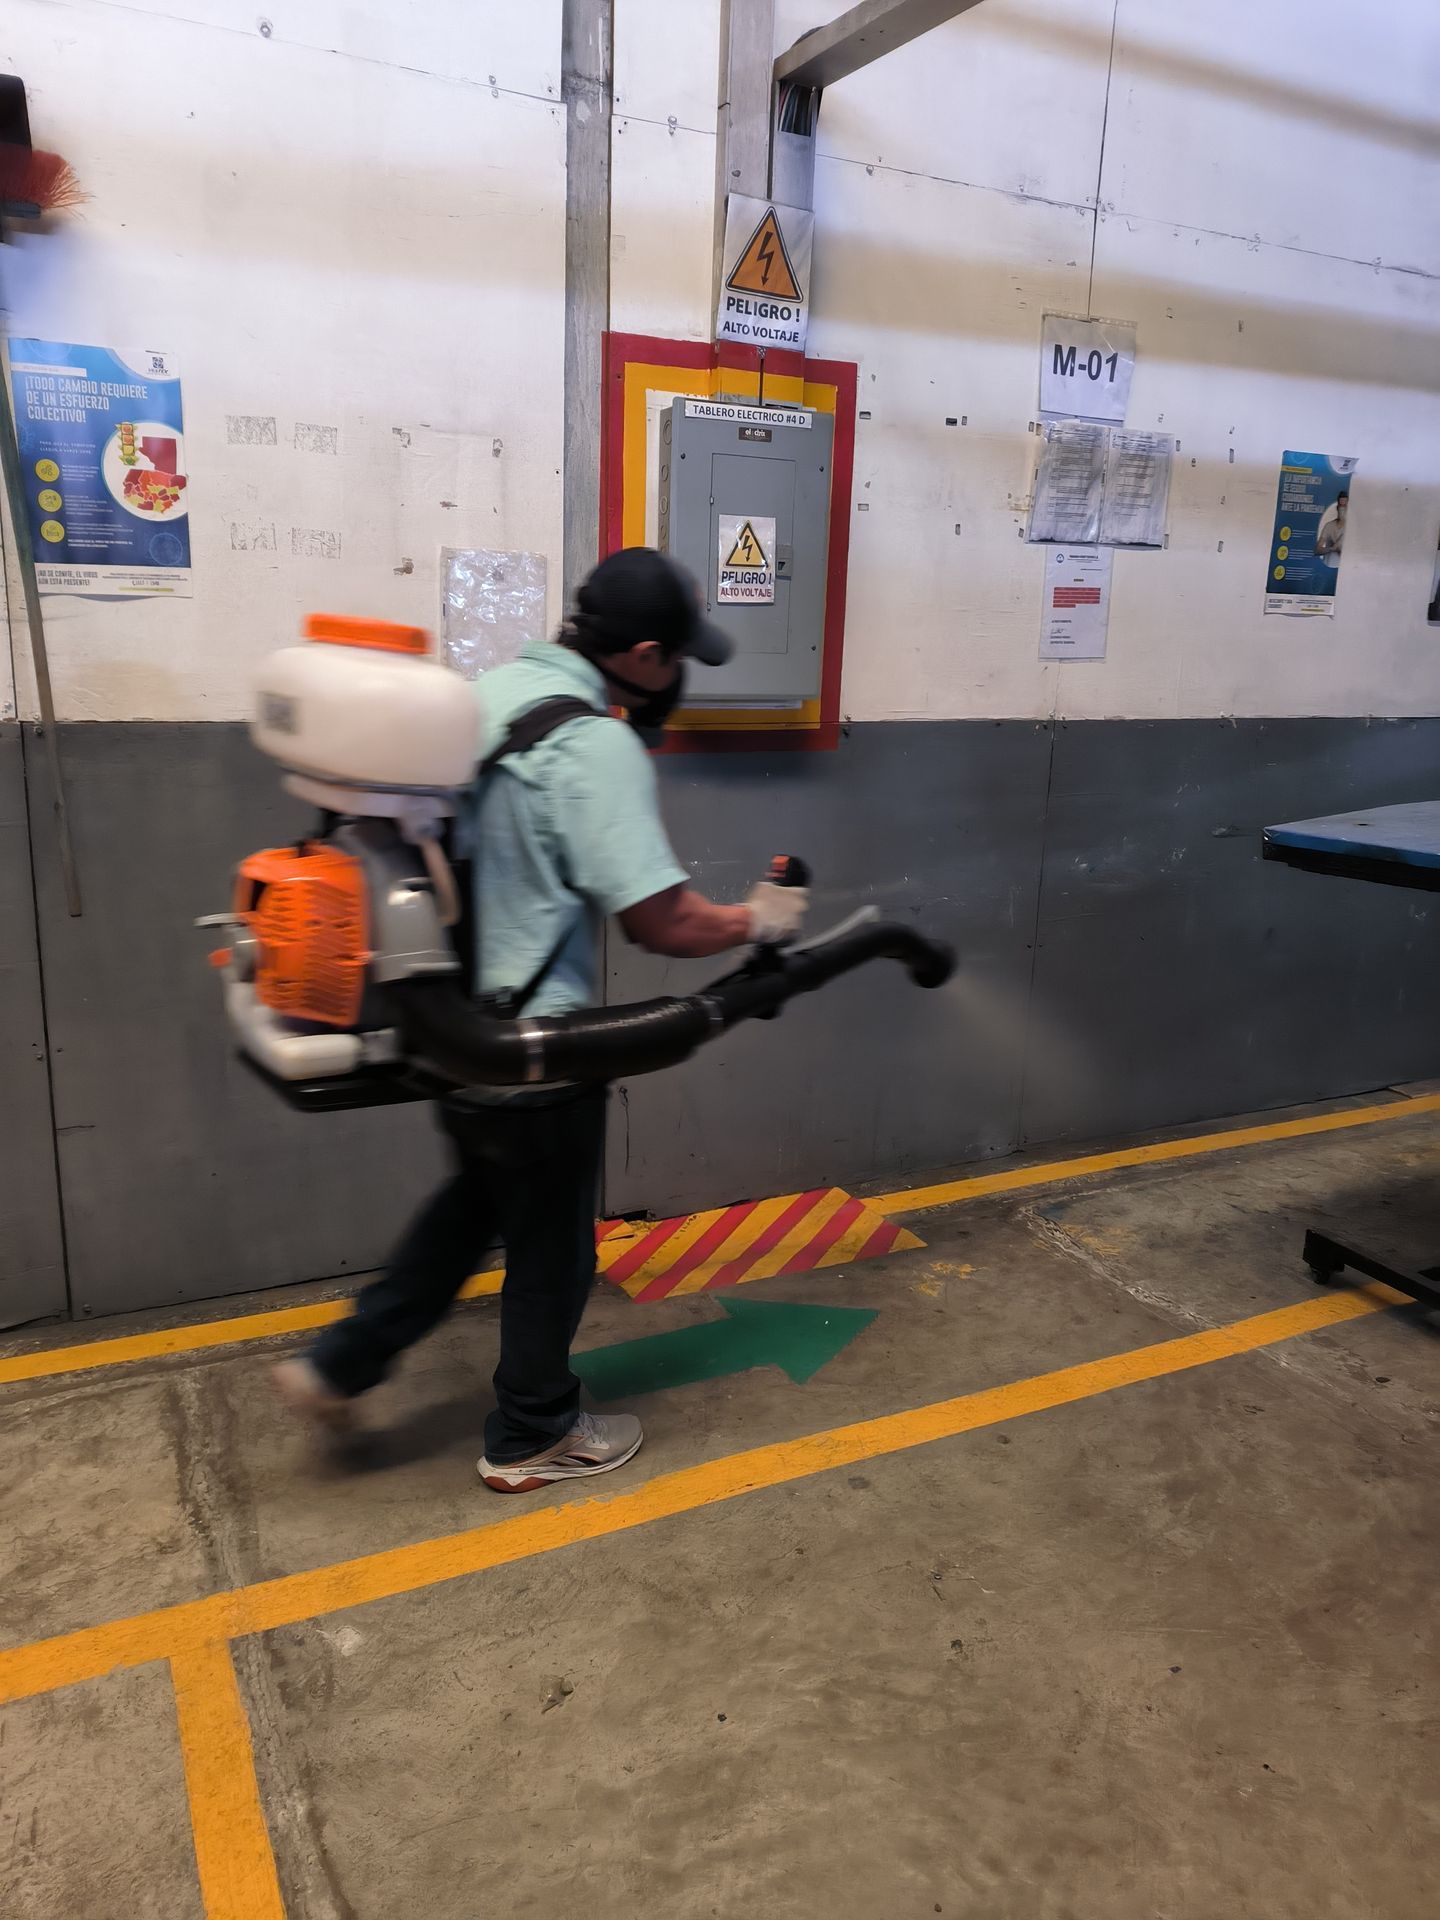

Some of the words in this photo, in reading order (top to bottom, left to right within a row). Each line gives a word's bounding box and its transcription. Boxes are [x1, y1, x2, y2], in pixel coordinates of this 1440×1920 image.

[726, 296, 792, 321] PELIGRO
[795, 308, 801, 322] !
[723, 321, 750, 335] ALTO
[752, 326, 799, 342] VOLTAJE
[1053, 344, 1118, 382] M-01
[58, 378, 98, 395] CAMBIO
[101, 383, 148, 399] REQUIERE
[26, 391, 41, 404] DE
[43, 392, 56, 406] UN
[60, 394, 110, 410] ESFUERZO
[27, 406, 87, 423] COLECTIVO!
[693, 405, 735, 418] TABLERO
[737, 409, 784, 423] ELECTRICO
[786, 414, 796, 424] #4
[798, 416, 806, 425] D
[721, 571, 767, 584] PELIGRO
[720, 587, 740, 597] ALTO
[741, 588, 773, 597] VOLTAJE
